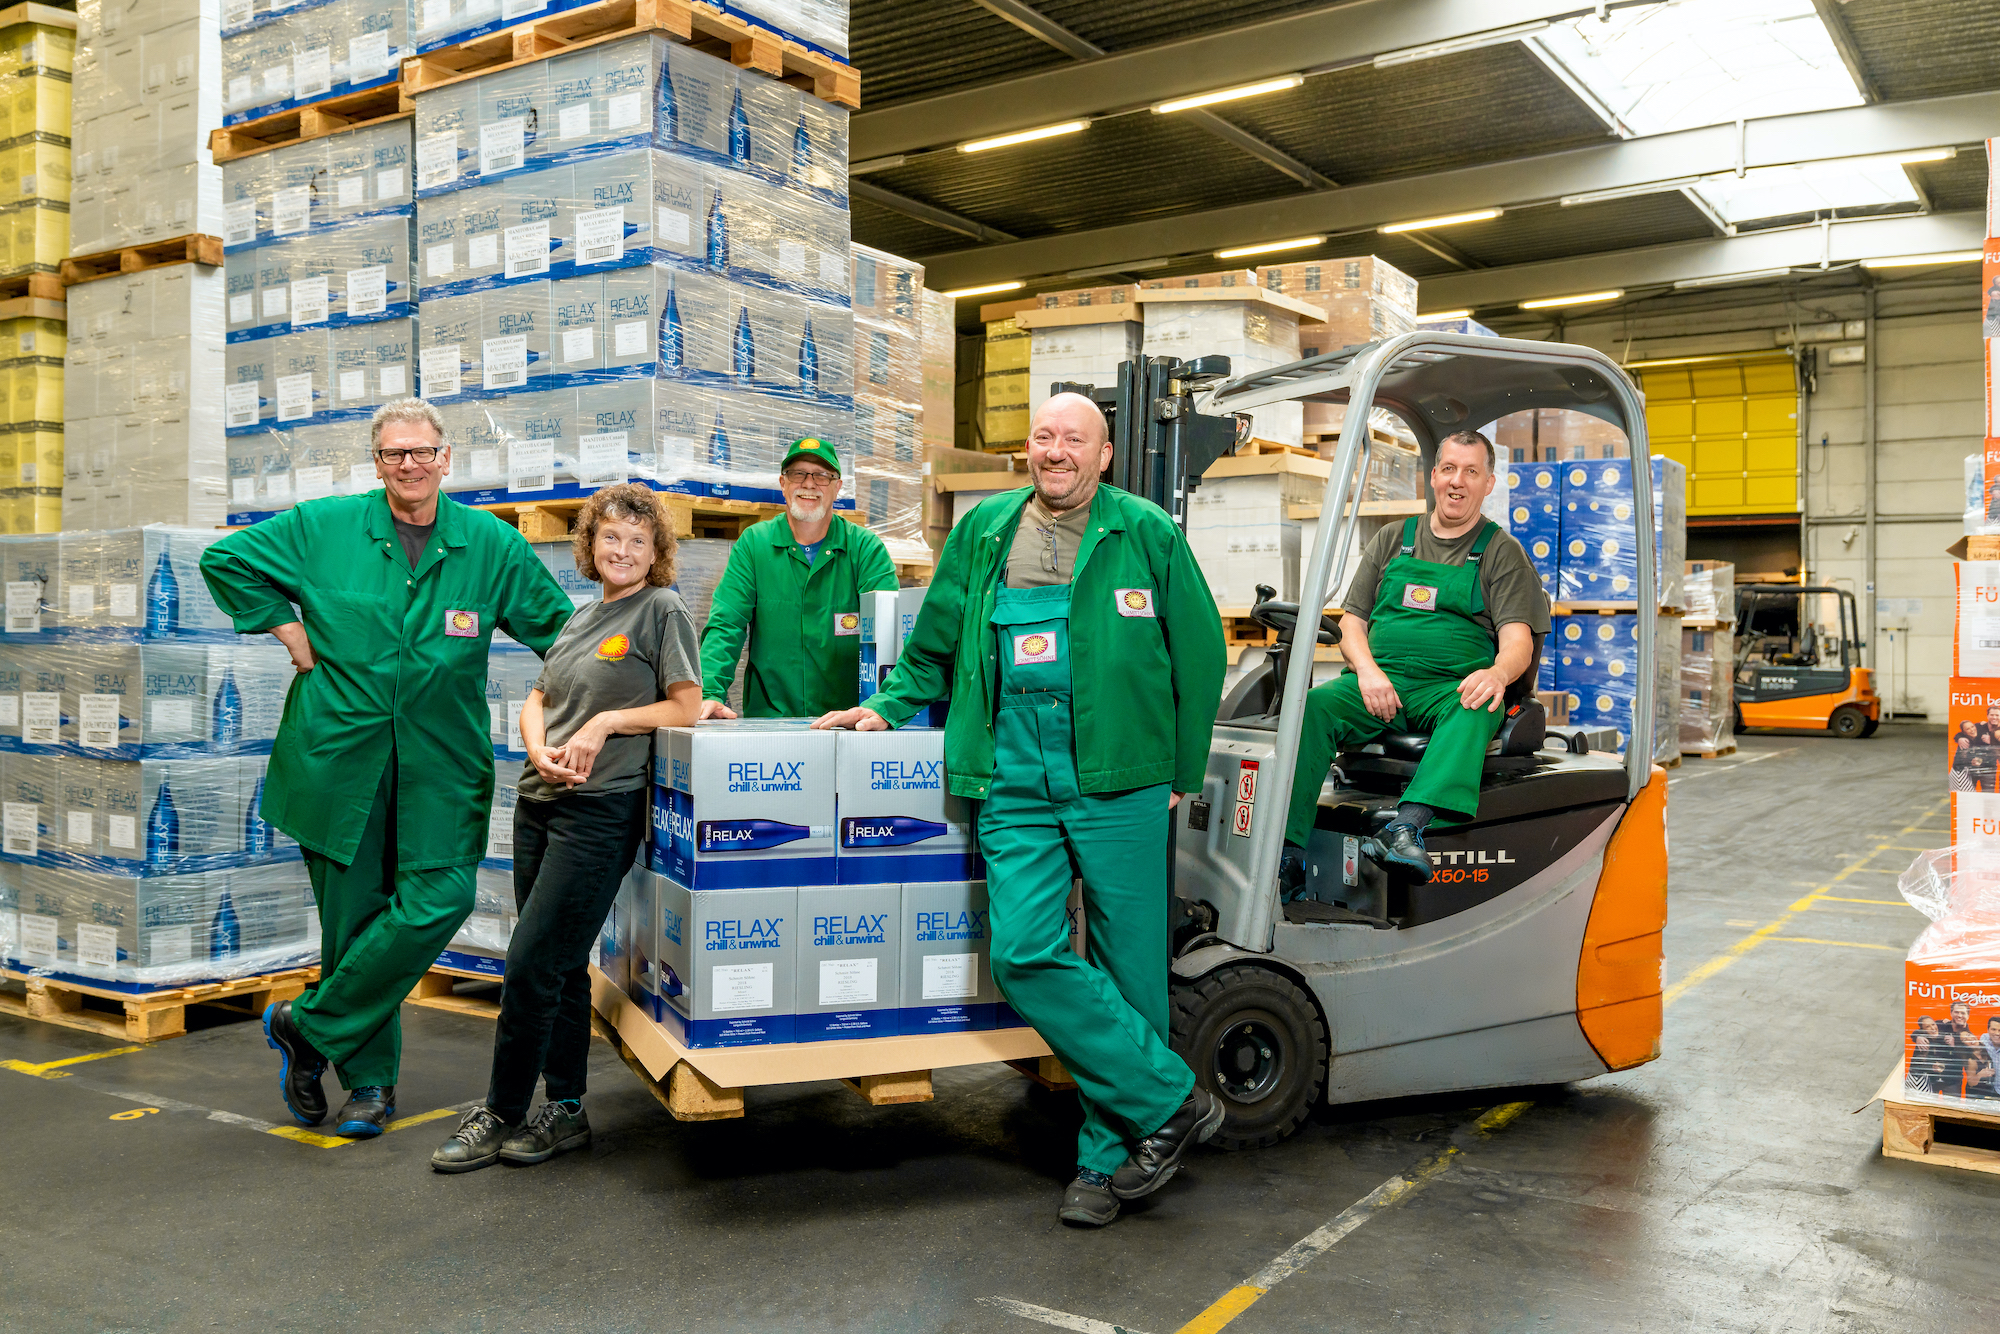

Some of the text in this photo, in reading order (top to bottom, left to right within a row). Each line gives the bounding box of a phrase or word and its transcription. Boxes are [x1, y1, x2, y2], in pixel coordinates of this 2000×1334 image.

[606, 67, 646, 85] RELAX
[555, 78, 592, 98] RELAX
[497, 93, 531, 113] RELAX
[661, 99, 672, 141] RELAX
[736, 122, 745, 163] RELAX
[375, 145, 407, 161] RELAX
[594, 183, 633, 201] RELAX
[655, 180, 692, 200] RELAX
[522, 198, 557, 215] RELAX
[595, 195, 633, 209] chill unwind.
[672, 199, 692, 210] unwind.
[465, 210, 499, 229] RELAX
[522, 215, 534, 223] chill
[579, 210, 622, 221] MANITOBA/Canada
[423, 219, 455, 236] RELAX
[714, 217, 724, 266] RELAX
[362, 245, 394, 261] RELAX
[1985, 252, 2000, 264] Fü
[228, 274, 254, 287] RELAX
[261, 267, 290, 279] RELAX
[559, 303, 596, 319] RELAX
[611, 295, 650, 312] RELAX
[500, 311, 534, 328] RELAX
[559, 315, 595, 327] chill unwind.
[435, 323, 468, 339] RELAX
[517, 324, 534, 332] unwind.
[337, 349, 366, 361] RELAX
[377, 343, 407, 358] RELAX
[667, 329, 676, 369] RELAX
[238, 363, 264, 377] RELAX
[289, 355, 317, 369] RELAX
[740, 343, 749, 386] RELAX
[526, 419, 563, 432] RELAX
[597, 410, 636, 426] RELAX
[660, 410, 696, 425] RELAX
[541, 430, 561, 439] unwind.
[583, 434, 625, 443] MANITOBA/Canada
[229, 457, 255, 468] RELAX
[309, 449, 337, 461] RELAX
[1986, 451, 2000, 462] Fü
[19, 562, 46, 574] RELAX
[107, 558, 140, 571] RELAX
[575, 582, 596, 590] unwind.
[157, 592, 169, 632] RELAX
[862, 617, 873, 633] RELAX
[902, 614, 920, 630] REL
[37, 673, 65, 687] RELAX
[861, 662, 875, 682] RELAX
[95, 675, 126, 687] RELAX
[147, 675, 199, 688] RELAX
[147, 688, 196, 696] chill unwind.
[1952, 692, 1982, 706] Fün
[222, 707, 234, 744] RELAX
[655, 755, 667, 774] ELAX
[673, 759, 689, 780] RELAX
[729, 762, 804, 781] RELAX
[871, 761, 943, 779] RELAX
[729, 781, 802, 792] chill & unwind.
[871, 779, 940, 790] chill & unwind.
[65, 785, 95, 801] RELAX
[107, 788, 138, 804] RELAX
[651, 805, 669, 832] RELAX
[672, 811, 692, 842] RELAX
[1973, 818, 2000, 835] Fü
[255, 815, 265, 853] RELAX
[713, 829, 754, 841] RELAX
[856, 826, 894, 837] RELAX
[157, 822, 169, 863] RELAX
[1427, 850, 1515, 865] STILL
[1428, 868, 1489, 883] X50-15
[92, 902, 124, 919] RELAX
[145, 902, 194, 920] RELAX
[665, 908, 682, 935] RELAX
[814, 914, 888, 935] RELAX
[917, 911, 987, 930] RELAX
[706, 918, 783, 940] RELAX
[917, 929, 985, 941] chill & unwind.
[706, 937, 780, 951] chill & unwind.
[814, 933, 885, 946] chill & unwind.
[1909, 981, 2000, 1006] Fün begins
